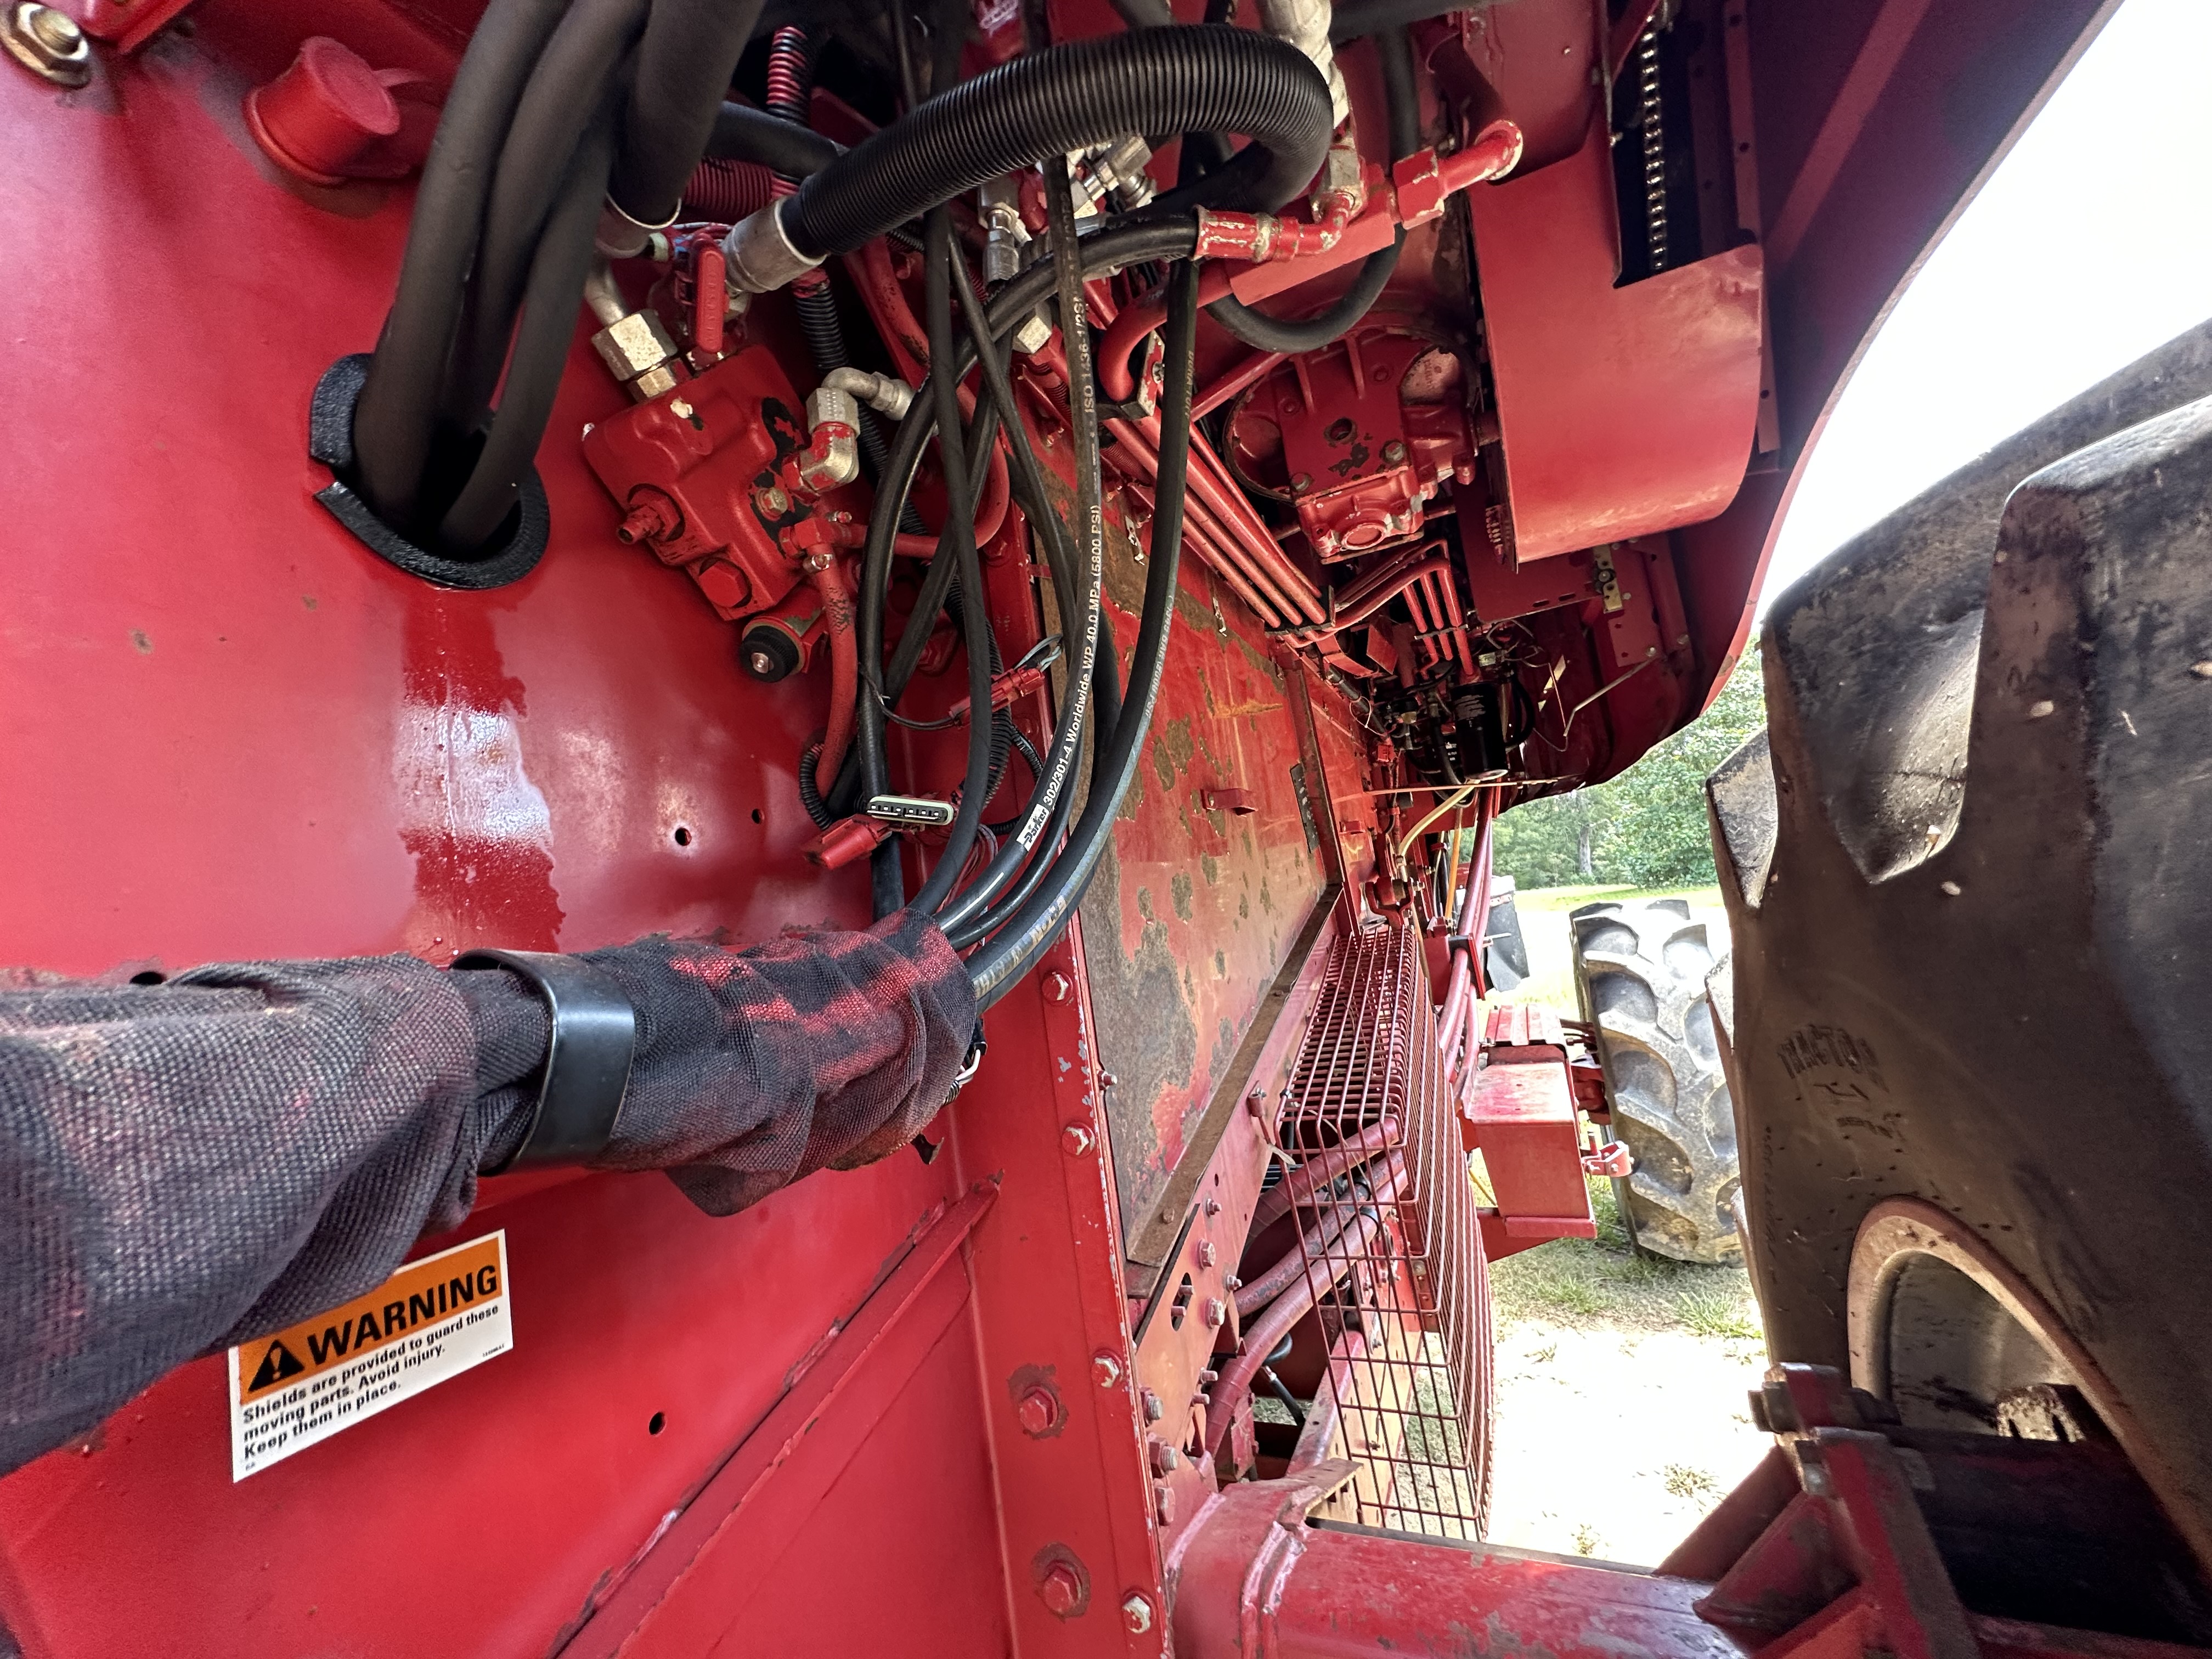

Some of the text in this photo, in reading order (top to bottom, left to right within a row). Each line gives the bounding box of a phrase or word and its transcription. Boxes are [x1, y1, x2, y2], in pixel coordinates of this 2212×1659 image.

[1082, 383, 1096, 413] ISO
[1090, 505, 1102, 535] PSI)
[1091, 539, 1102, 577] (5800
[1088, 580, 1101, 610] MPa
[1086, 614, 1099, 644] 40.0
[1082, 646, 1095, 669] WP
[1065, 673, 1090, 743] Worldwide
[1042, 746, 1073, 806] 302/301-4
[307, 1265, 498, 1366] WARNING
[243, 1305, 499, 1424] Shields are provided to guard these
[244, 1346, 445, 1447] moving parts. Avoid injury.
[244, 1381, 402, 1460] Keep them in place.
